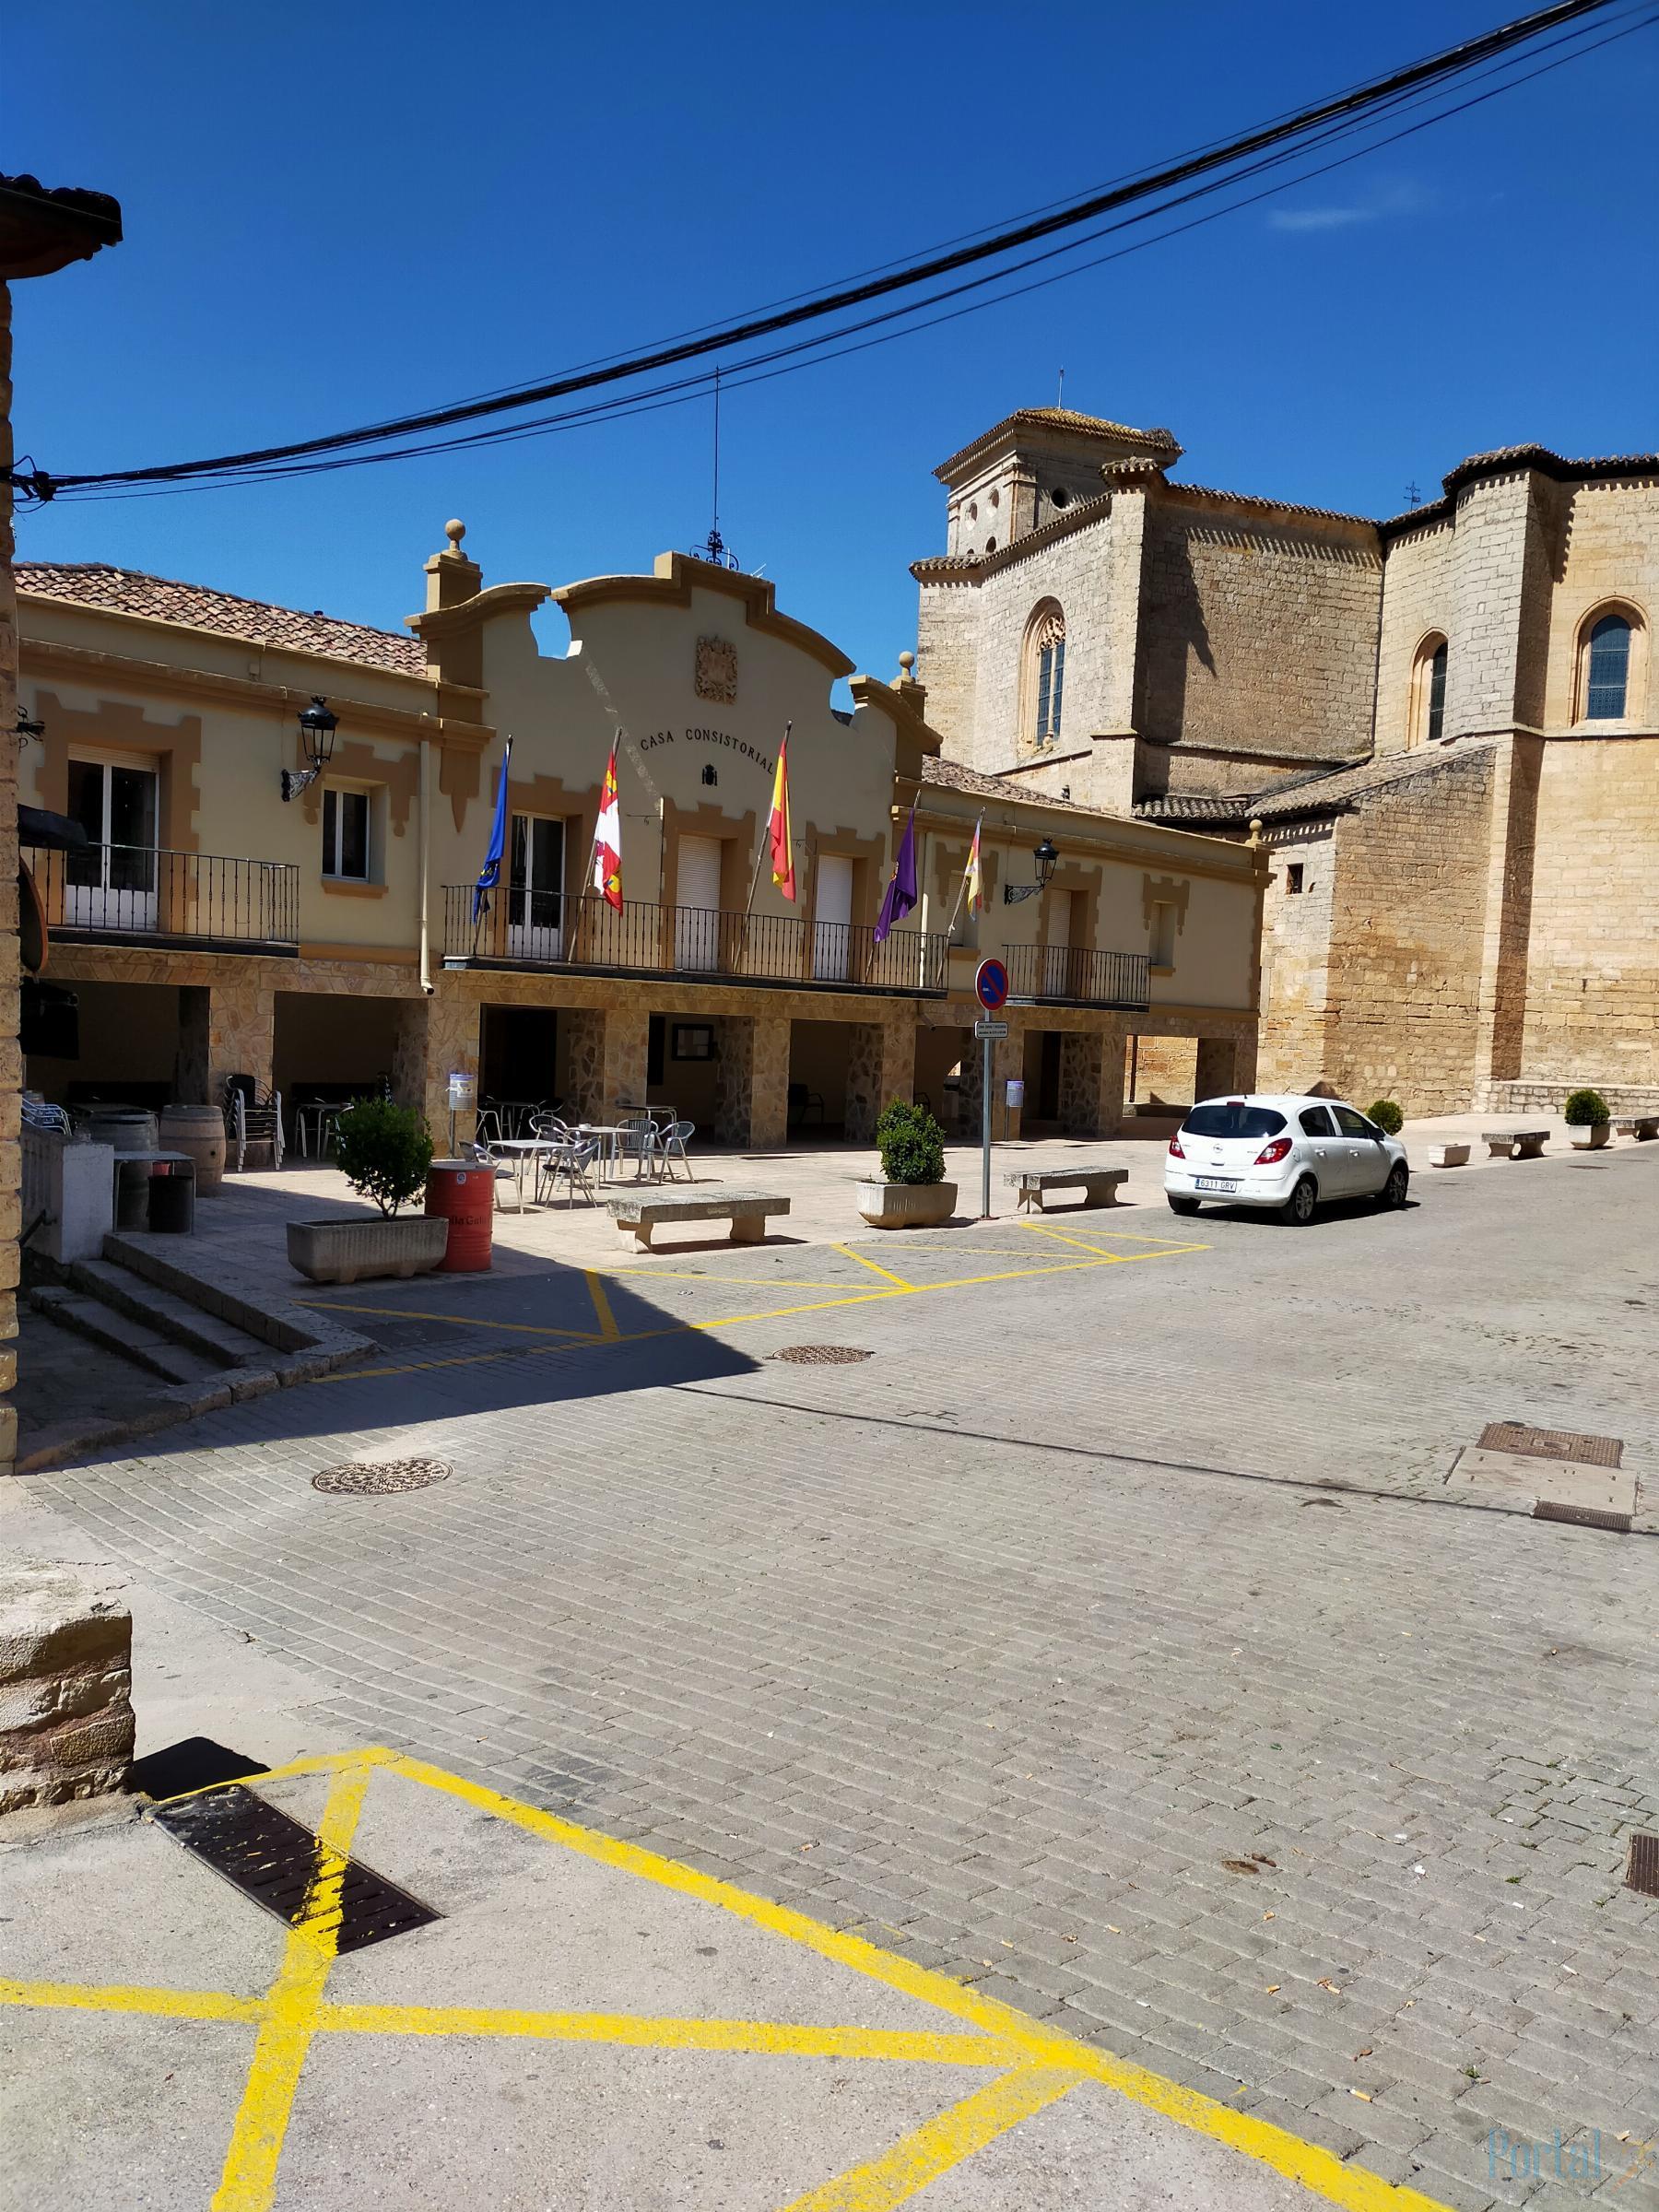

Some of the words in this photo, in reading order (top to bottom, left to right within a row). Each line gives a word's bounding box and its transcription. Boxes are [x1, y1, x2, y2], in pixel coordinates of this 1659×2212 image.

[641, 731, 674, 751] CASA
[686, 729, 773, 775] CONSISTORIAL
[1200, 1180, 1218, 1188] 6311
